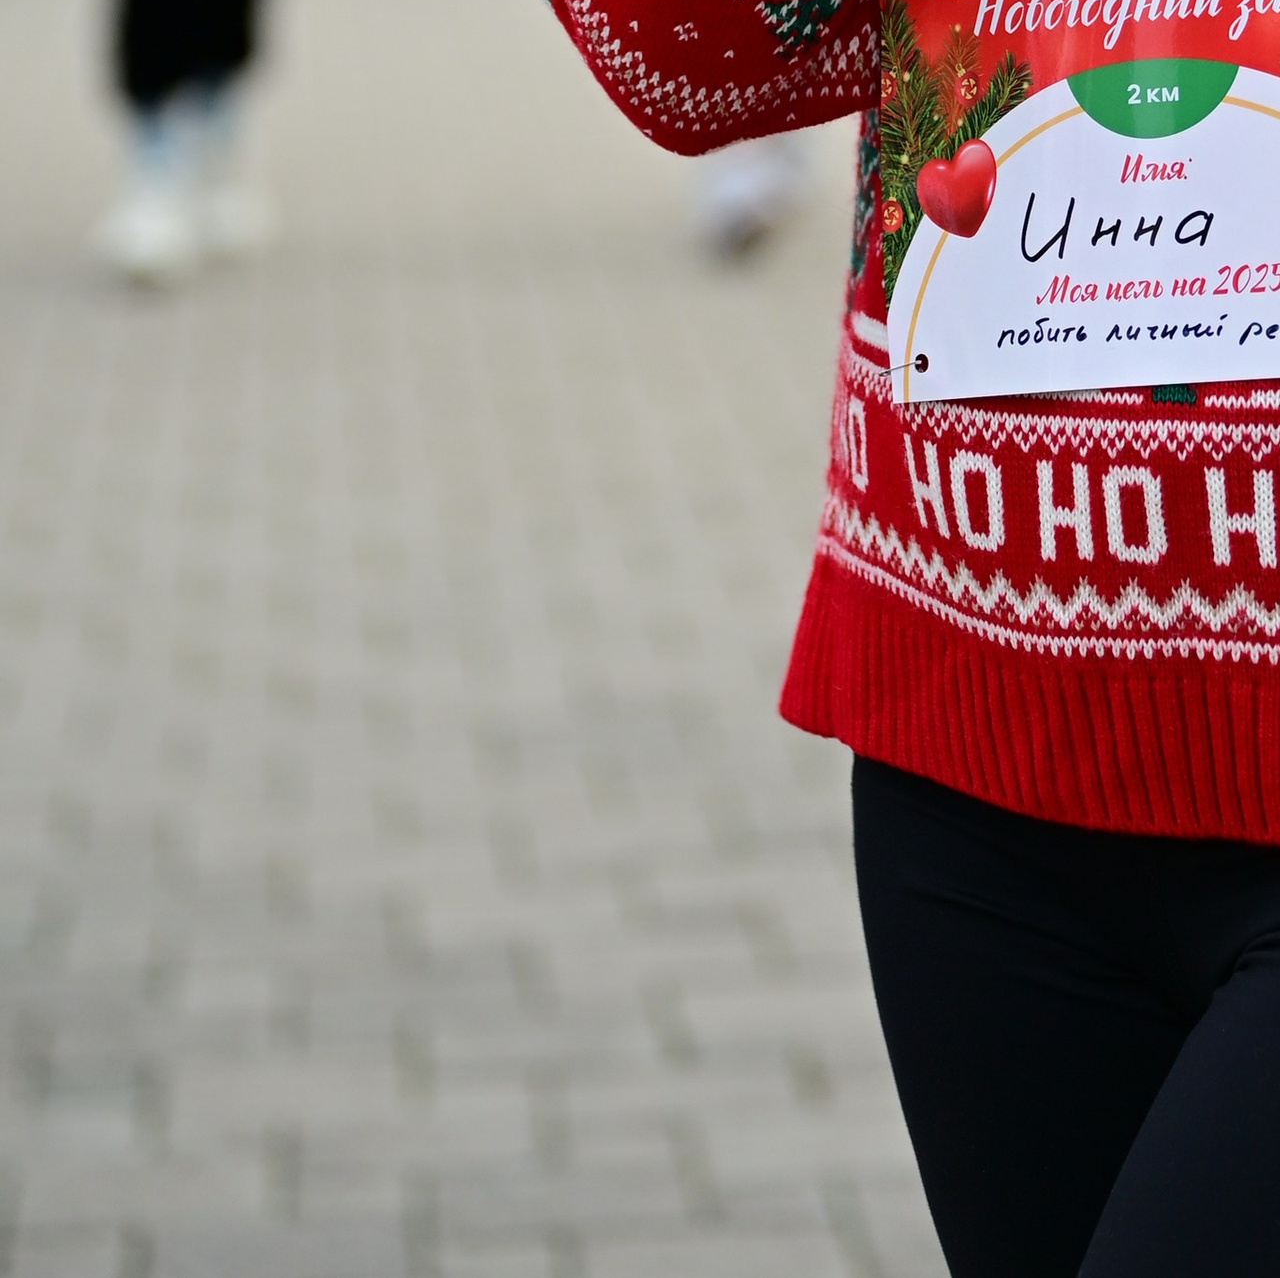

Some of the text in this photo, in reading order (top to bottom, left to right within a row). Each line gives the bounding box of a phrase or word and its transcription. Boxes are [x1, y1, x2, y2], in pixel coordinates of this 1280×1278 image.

[1127, 84, 1142, 105] 2
[1120, 153, 1193, 184] Имя:
[1021, 192, 1214, 263] Инна
[1036, 274, 1099, 305] Моя
[1104, 278, 1164, 302] цель
[1171, 276, 1207, 297] на
[997, 317, 1088, 348] побить
[902, 432, 1006, 552] HO
[1036, 460, 1169, 566] HO
